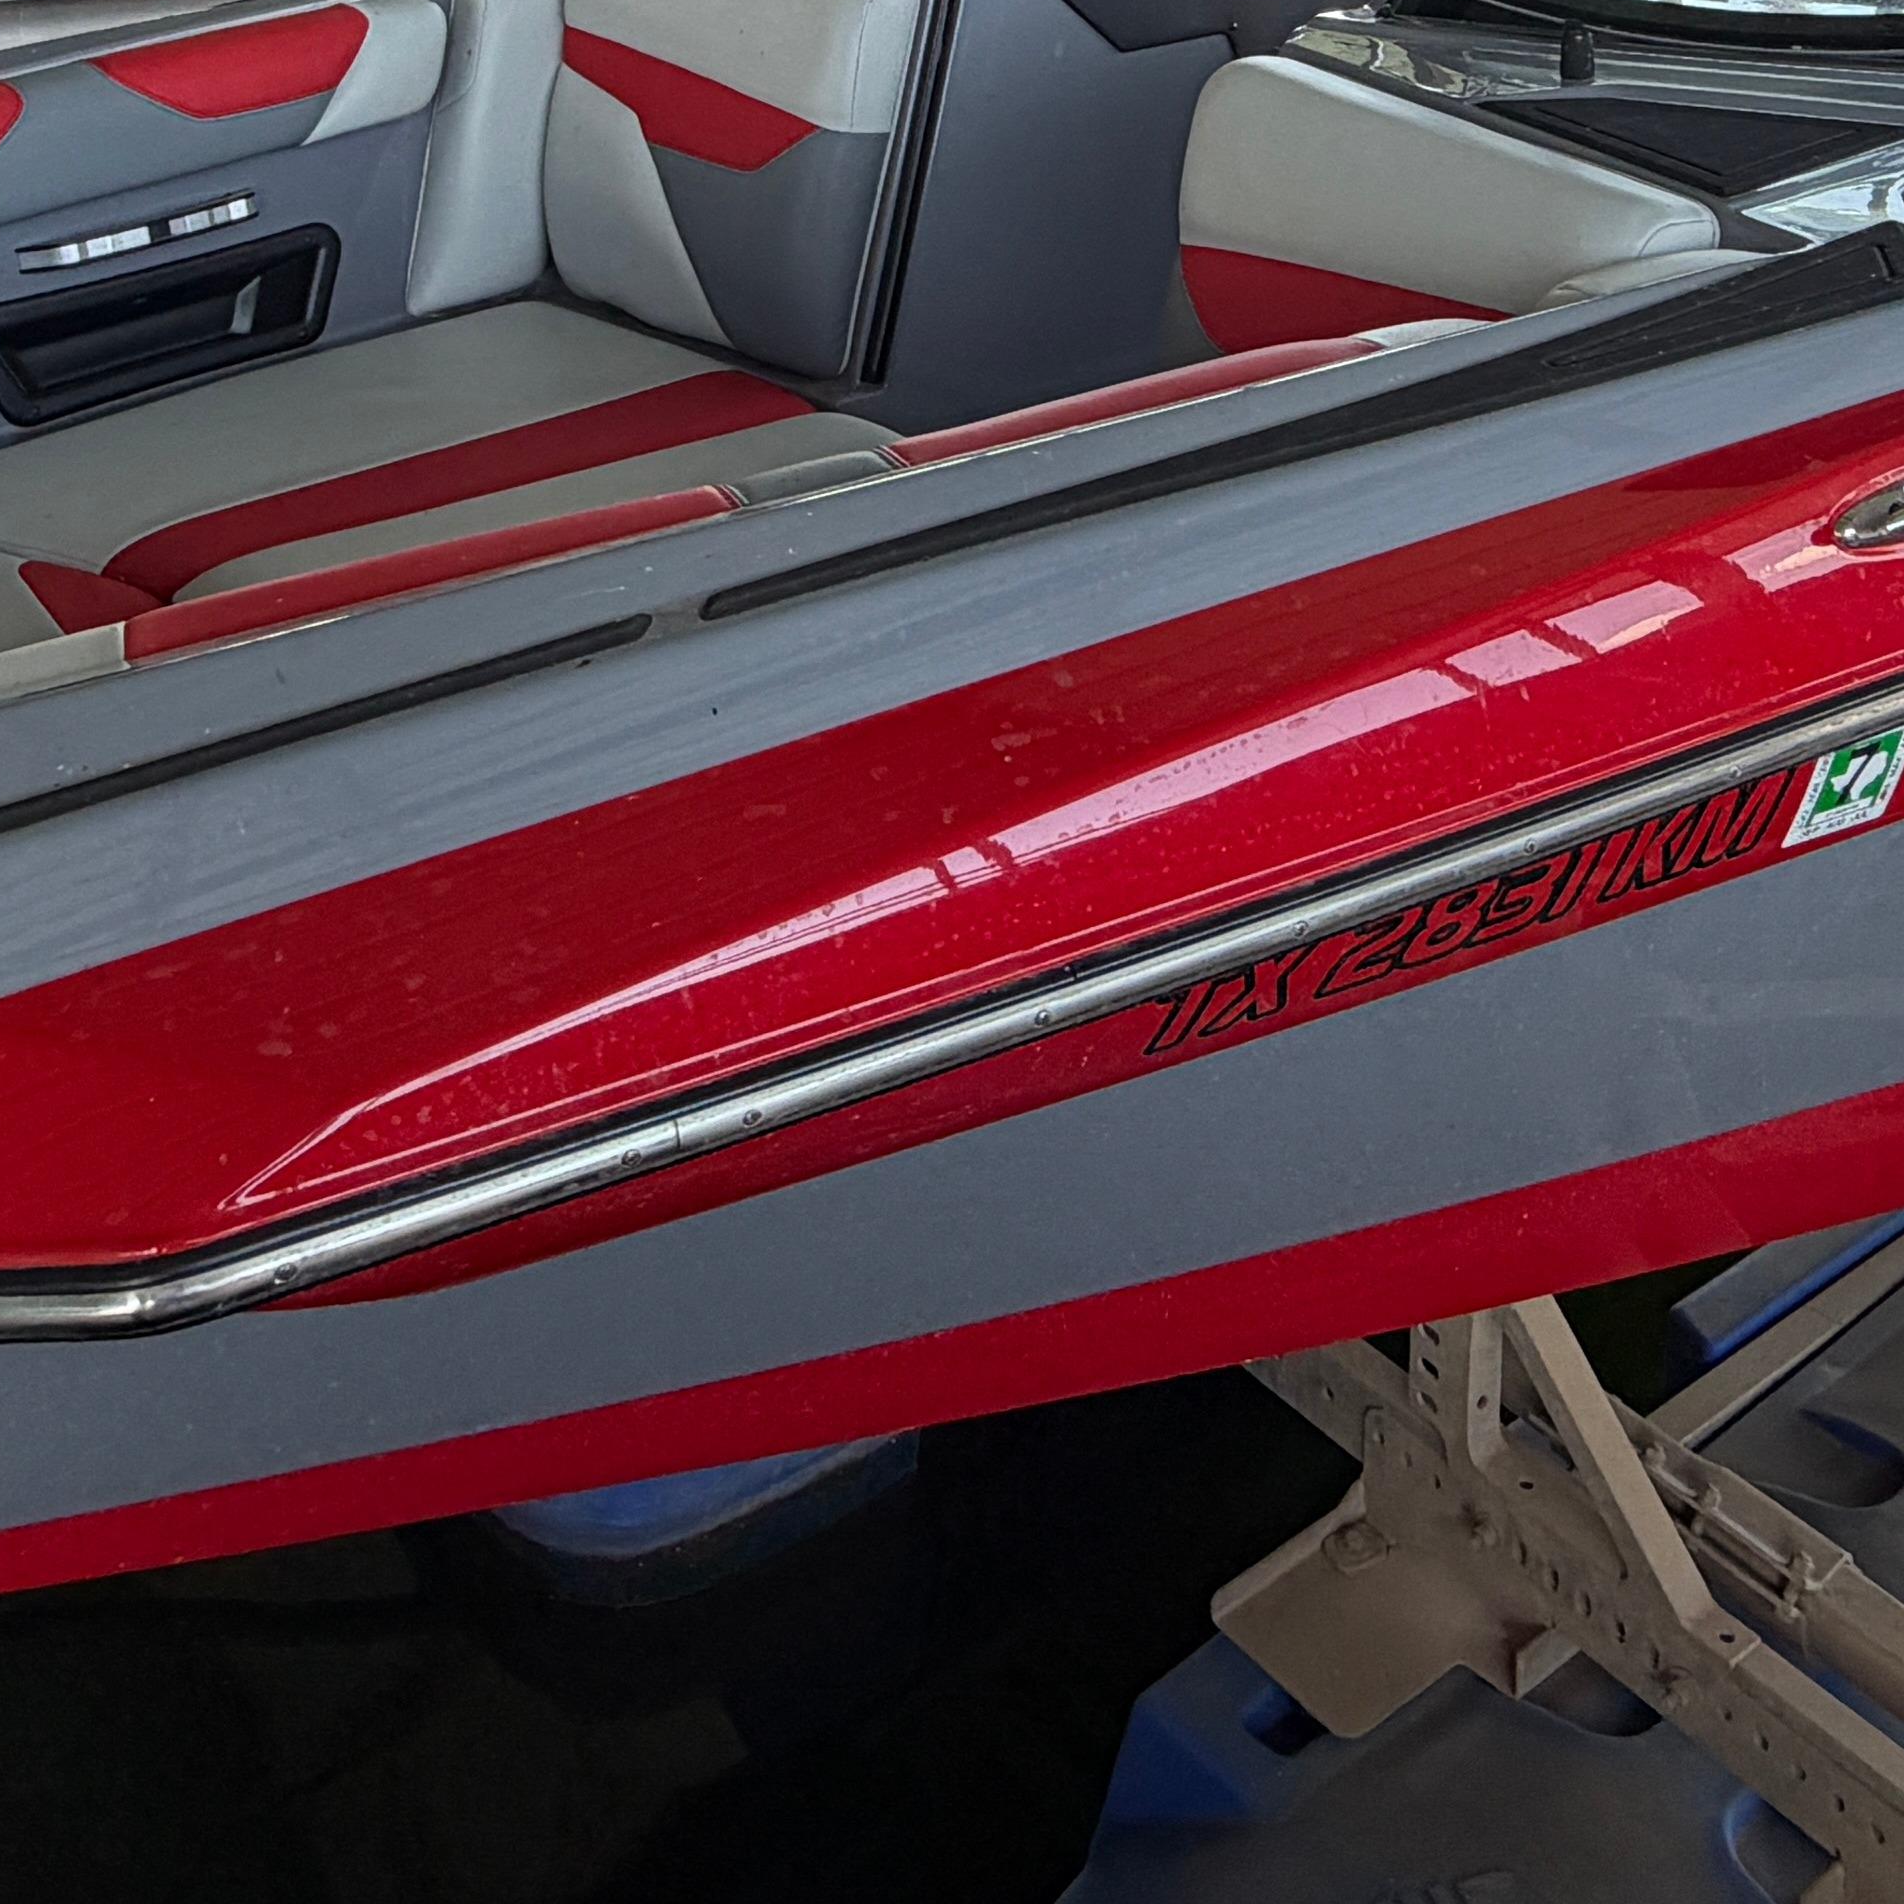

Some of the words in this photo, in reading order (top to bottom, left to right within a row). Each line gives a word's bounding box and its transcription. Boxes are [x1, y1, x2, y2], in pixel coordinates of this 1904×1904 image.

[1836, 740, 1882, 807] 7
[1142, 941, 1318, 1056] TX
[1312, 839, 1606, 999] 2831
[1598, 768, 1794, 903] KM
